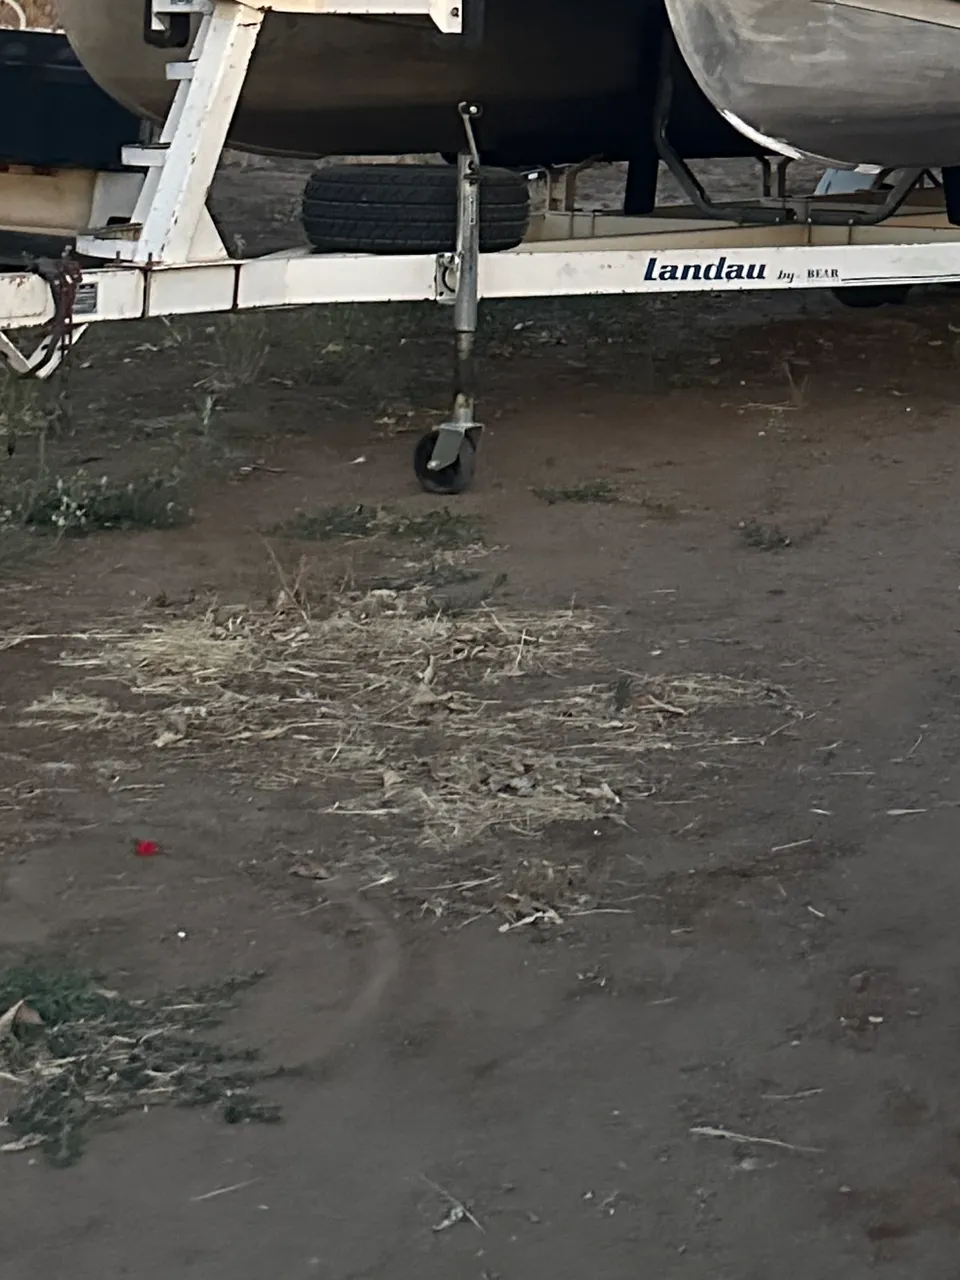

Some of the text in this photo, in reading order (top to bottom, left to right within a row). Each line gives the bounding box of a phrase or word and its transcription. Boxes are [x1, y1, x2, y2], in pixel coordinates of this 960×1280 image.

[643, 257, 839, 283] Landau by BEAR
